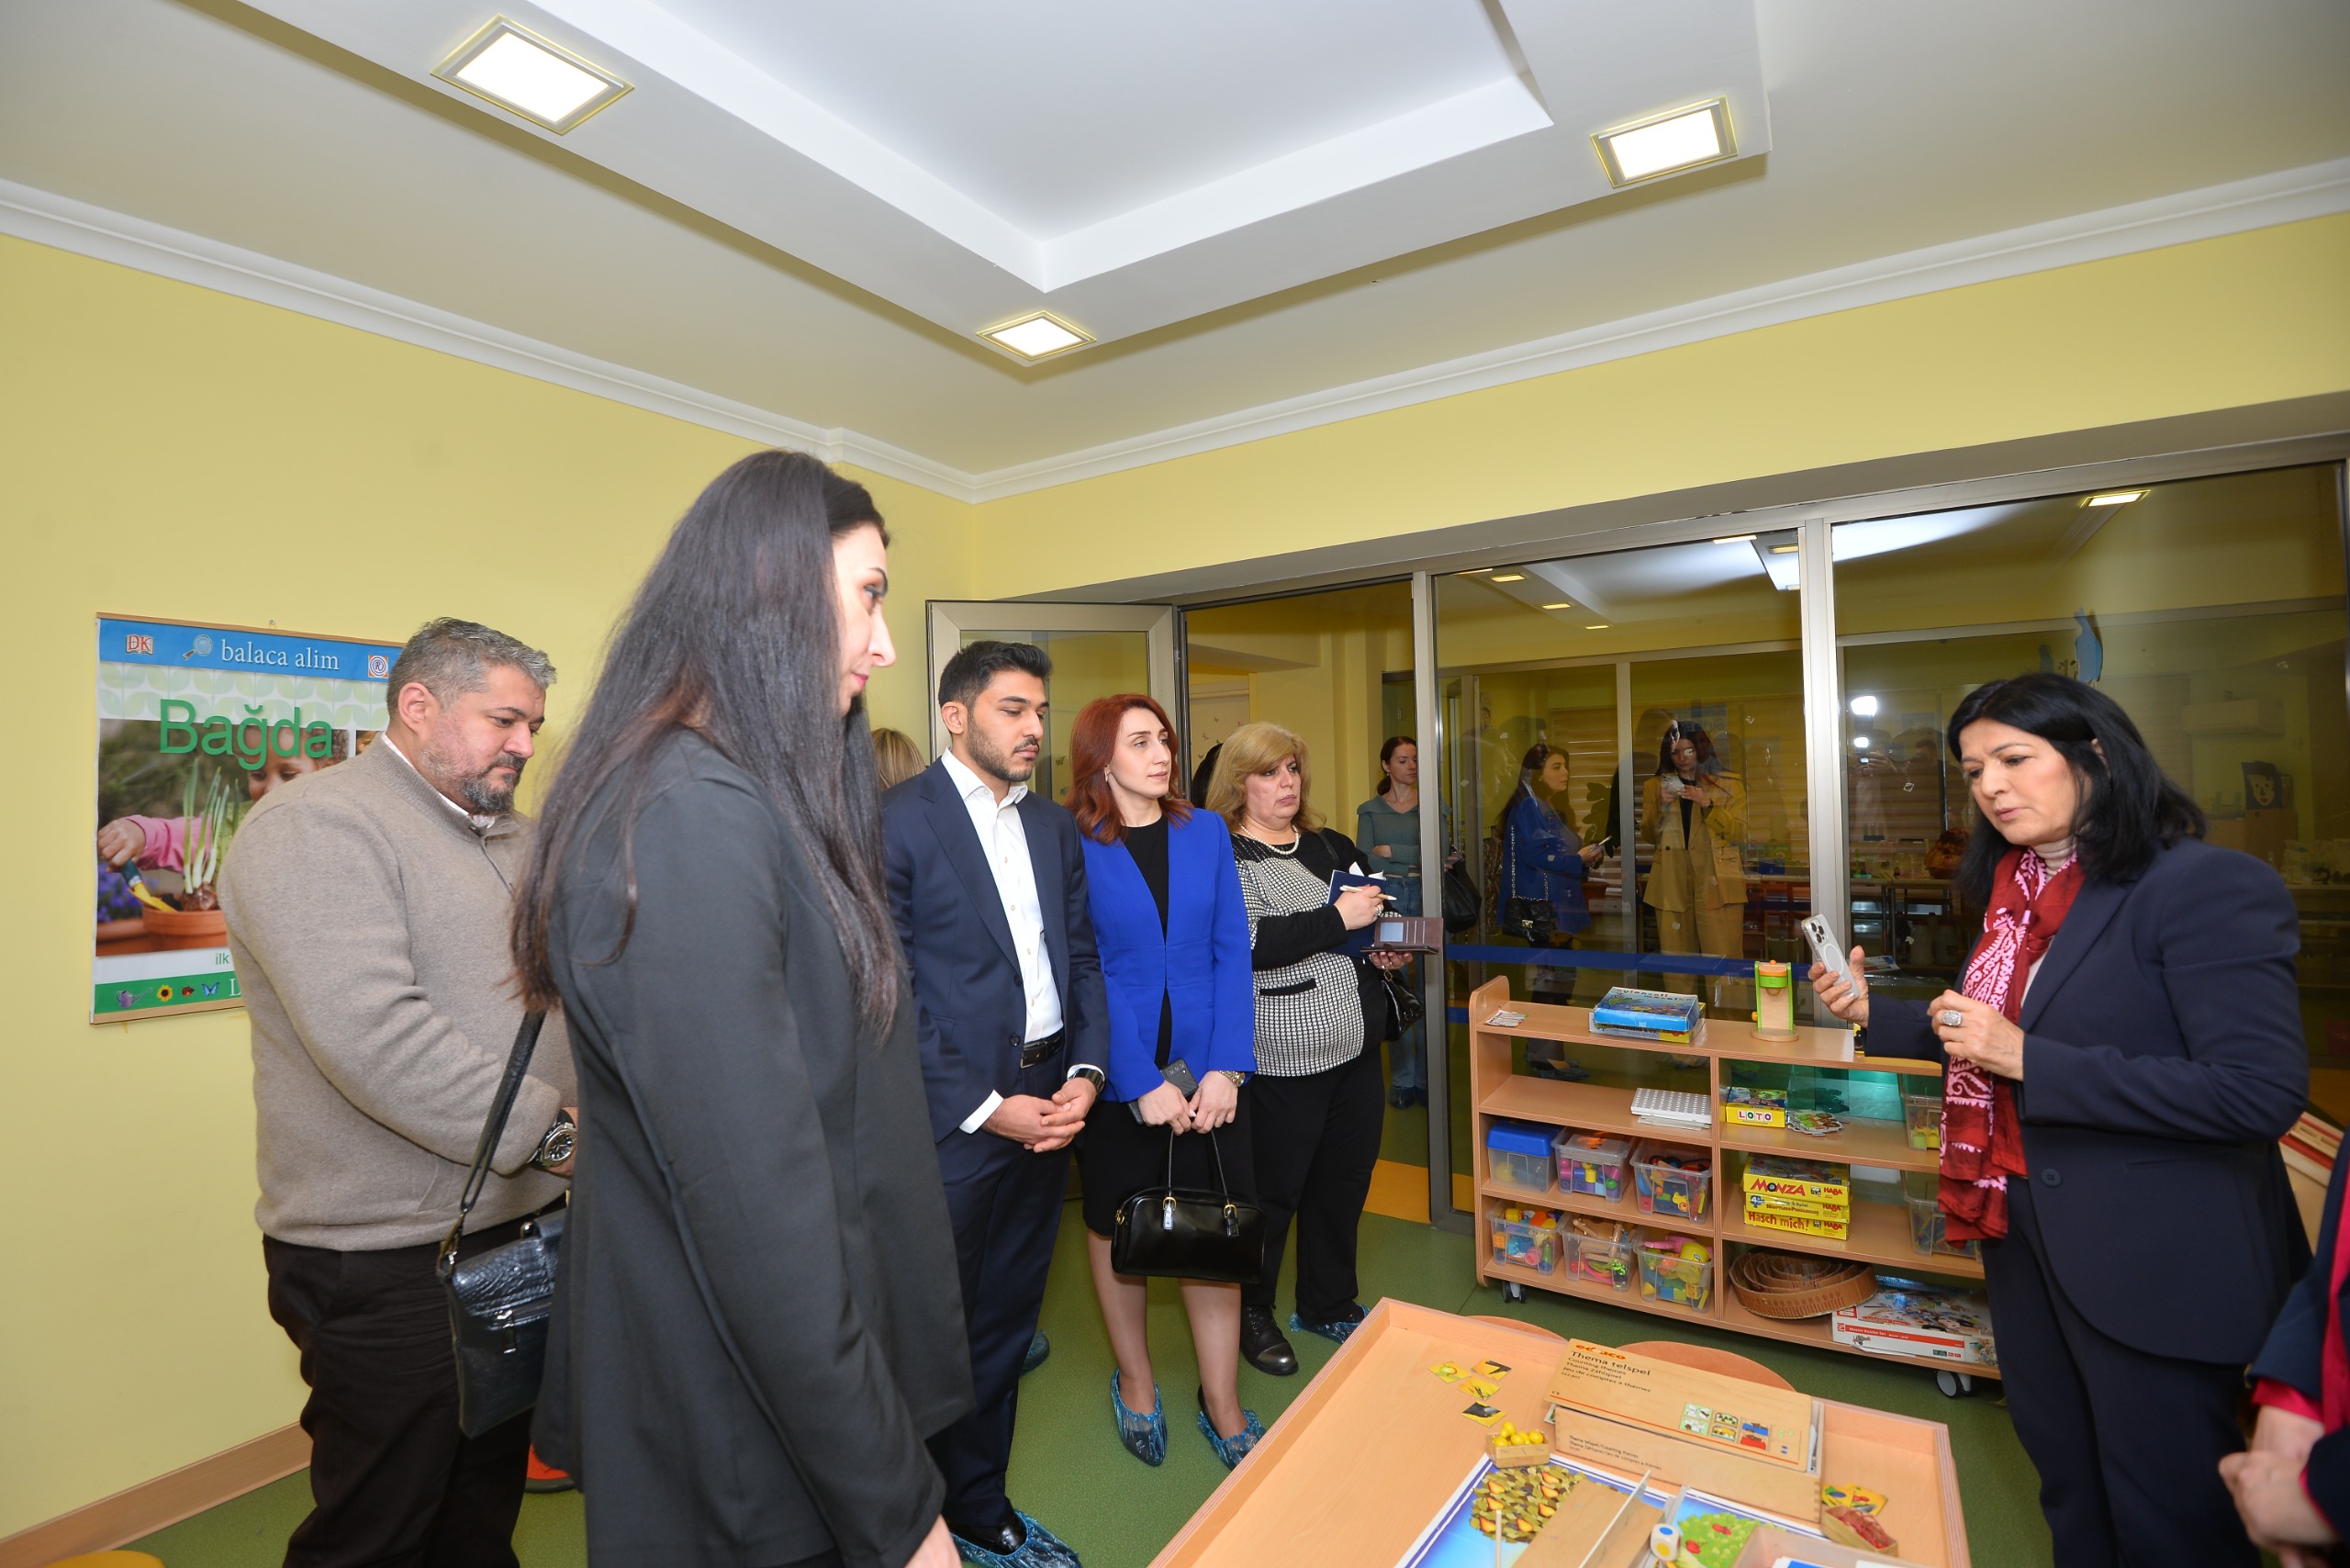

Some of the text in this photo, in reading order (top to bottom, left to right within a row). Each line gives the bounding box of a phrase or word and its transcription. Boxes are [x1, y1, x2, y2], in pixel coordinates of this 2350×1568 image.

[127, 634, 152, 652] DK
[221, 639, 340, 670] balaca alim
[160, 698, 333, 770] Bağda
[215, 953, 229, 965] ilk
[1738, 1111, 1772, 1121] LOTO
[1750, 1178, 1806, 1197] MONZA
[1823, 1187, 1843, 1196] HABA
[1822, 1204, 1841, 1212] HABA
[1748, 1212, 1777, 1225] Hasch
[1780, 1217, 1810, 1231] mich!
[1823, 1221, 1843, 1231] HABA
[1566, 1361, 1589, 1372] Thema
[1568, 1357, 1627, 1375] Counting themes
[1572, 1350, 1651, 1376] Thema telspel
[1586, 1372, 1617, 1383] comptes
